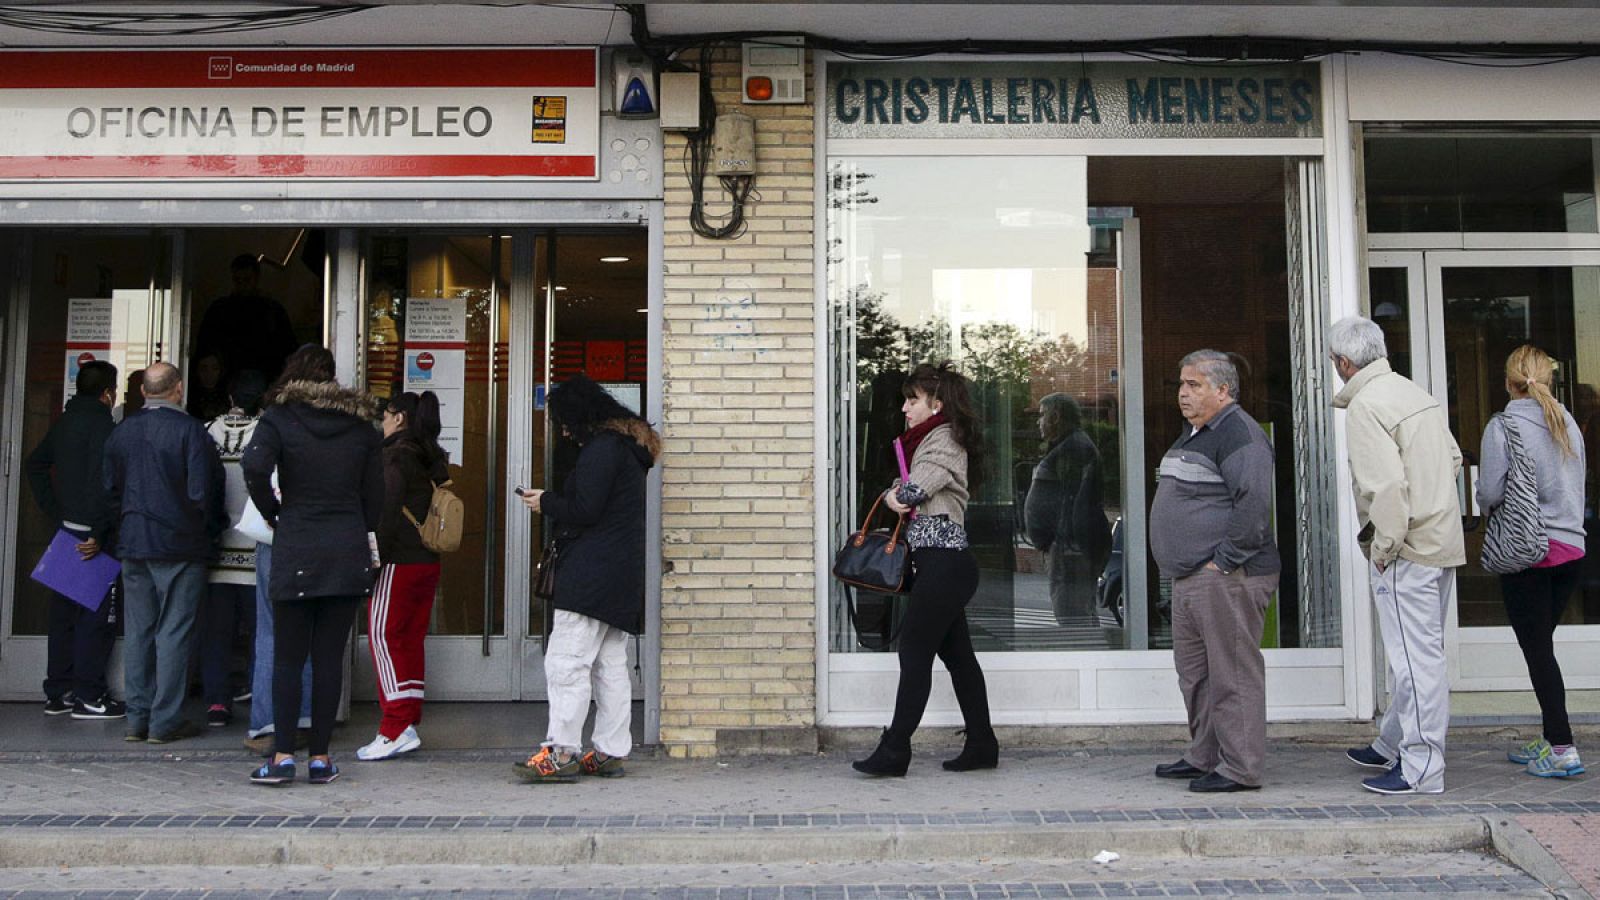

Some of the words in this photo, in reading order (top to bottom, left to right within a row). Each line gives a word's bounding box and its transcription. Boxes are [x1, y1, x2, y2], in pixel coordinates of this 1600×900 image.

[235, 63, 297, 73] Comunidad
[299, 63, 313, 73] de
[316, 63, 355, 73] Madrid
[835, 77, 1101, 125] CRISTALERIA
[1127, 77, 1314, 125] MENESES
[67, 106, 236, 138] OFICINA
[251, 105, 307, 138] DE
[320, 105, 493, 137] EMPLEO
